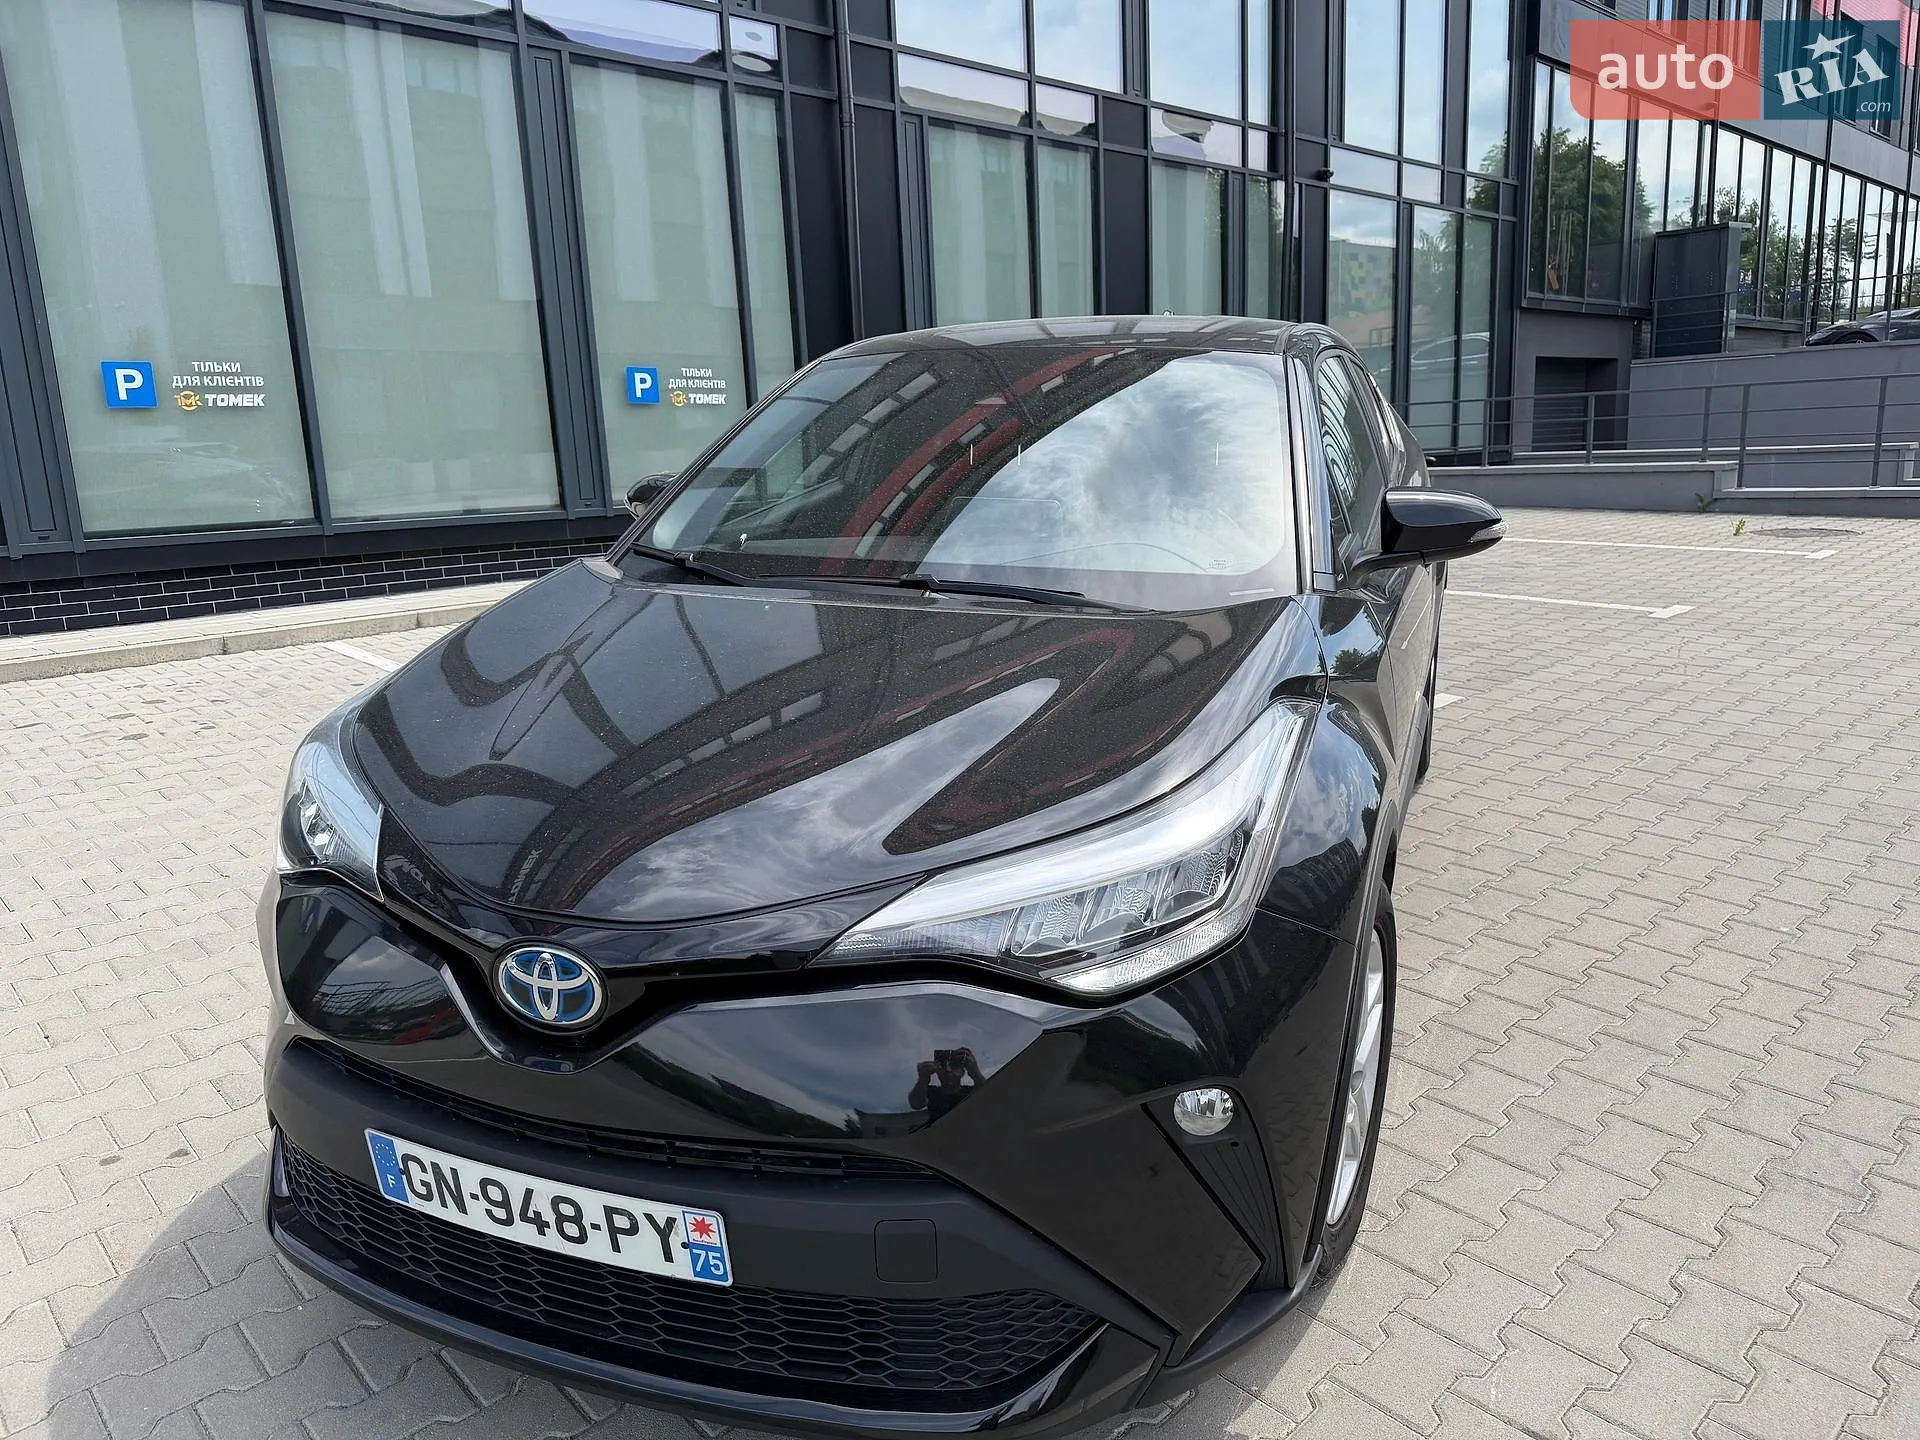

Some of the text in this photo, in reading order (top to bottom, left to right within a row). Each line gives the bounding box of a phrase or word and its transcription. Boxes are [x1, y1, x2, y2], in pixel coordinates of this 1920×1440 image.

[191, 361, 241, 373] ТІЛЬКИ
[681, 367, 713, 378] ТІЛЬКИ
[114, 368, 144, 401] P
[172, 375, 265, 389] ДЛЯ КЛІЄНТІВ
[633, 372, 653, 398] P
[668, 379, 727, 389] ДЛЯ КЛІЄНТІВ
[386, 1173, 396, 1188] F
[401, 1153, 679, 1264] GN-948-PY
[692, 1248, 724, 1275] 75
